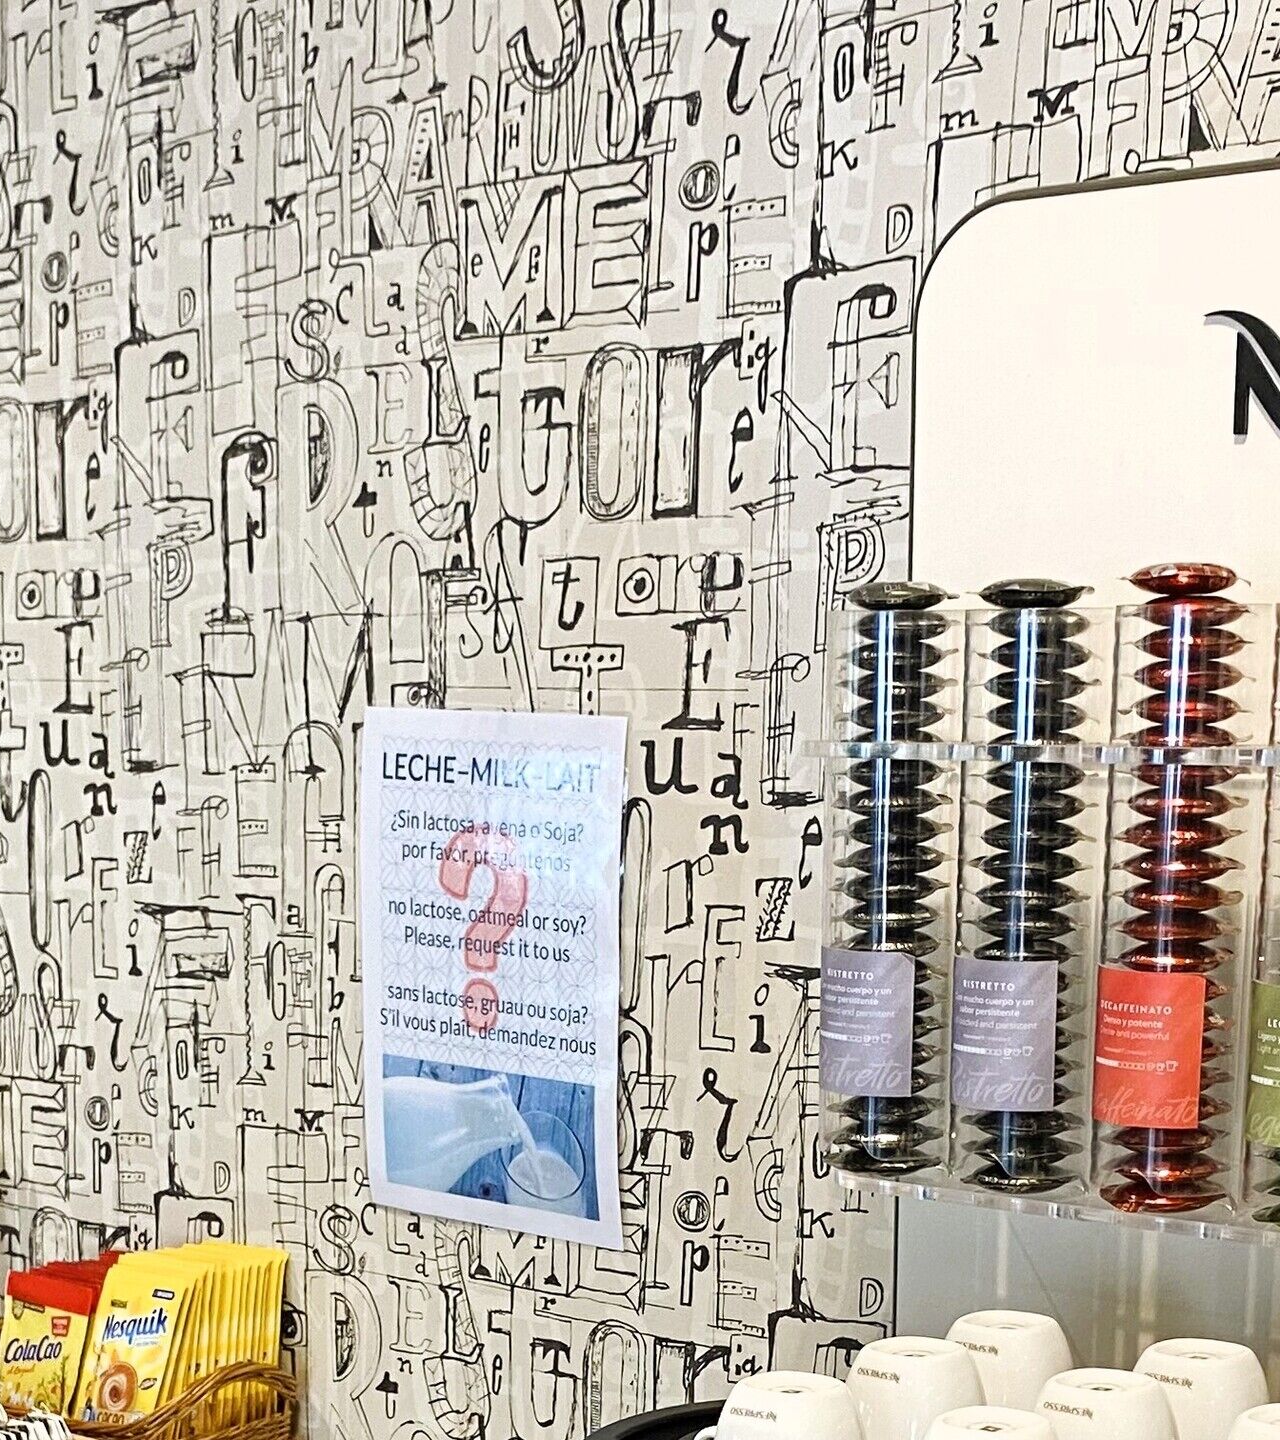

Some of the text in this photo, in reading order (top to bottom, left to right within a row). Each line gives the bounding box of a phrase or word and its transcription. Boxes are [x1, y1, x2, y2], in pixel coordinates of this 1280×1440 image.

[390, 810, 420, 832] ¿Sin
[423, 811, 479, 836] lactosa,
[544, 822, 584, 845] Soja?
[402, 844, 427, 861] por
[389, 900, 406, 915] no
[469, 907, 528, 928] oatmeal
[533, 915, 550, 930] or
[553, 916, 586, 937] soy?
[458, 936, 515, 957] request
[519, 938, 530, 958] it
[533, 944, 549, 960] to
[553, 948, 570, 963] us
[388, 985, 588, 1027] sans lactose, gruau ou soja?
[403, 1014, 436, 1032] vous
[479, 1022, 556, 1050] demandez
[560, 1038, 596, 1056] nous
[102, 1308, 168, 1345] Nesquik
[4, 1335, 62, 1363] ColaCao
